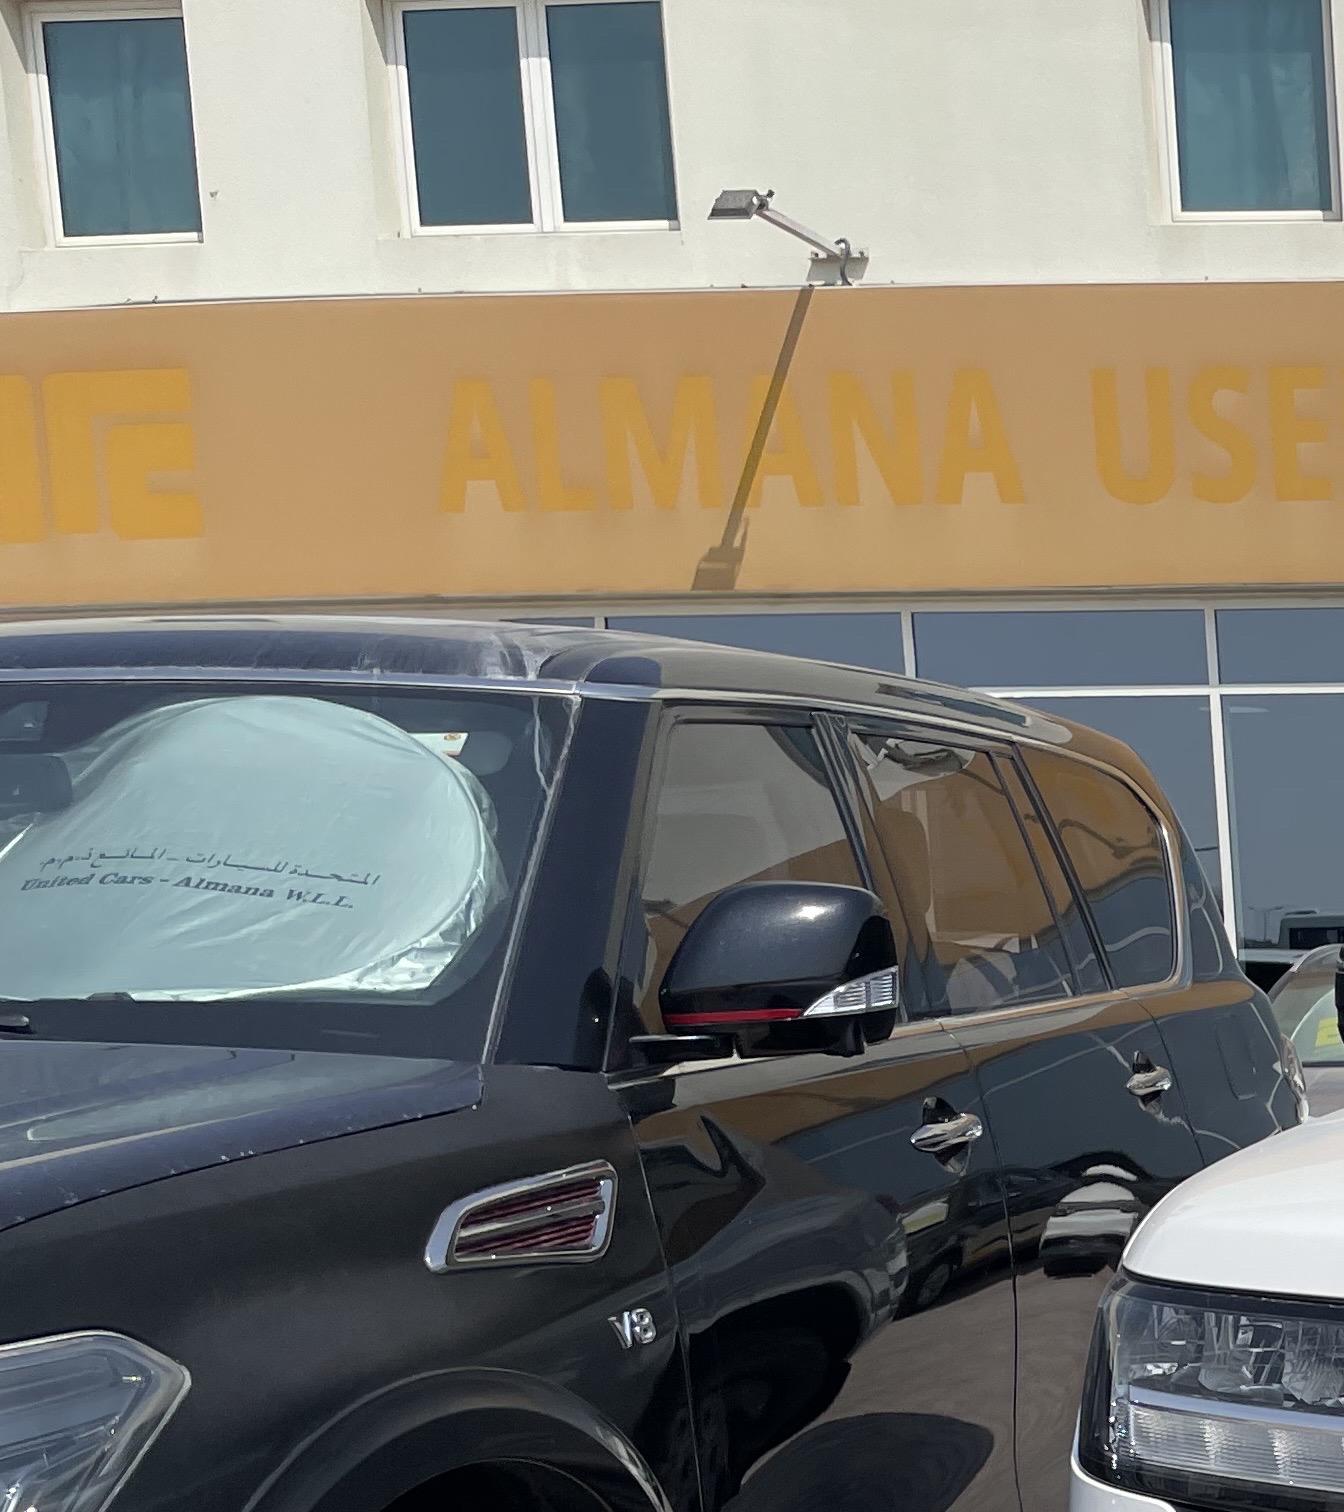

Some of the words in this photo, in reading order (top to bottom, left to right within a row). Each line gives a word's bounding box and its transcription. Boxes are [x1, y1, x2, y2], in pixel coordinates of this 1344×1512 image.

[440, 367, 1025, 514] ALMANA
[20, 873, 96, 891] United
[99, 872, 154, 885] Cars
[171, 876, 275, 898] Almana
[607, 1307, 657, 1350] V8
